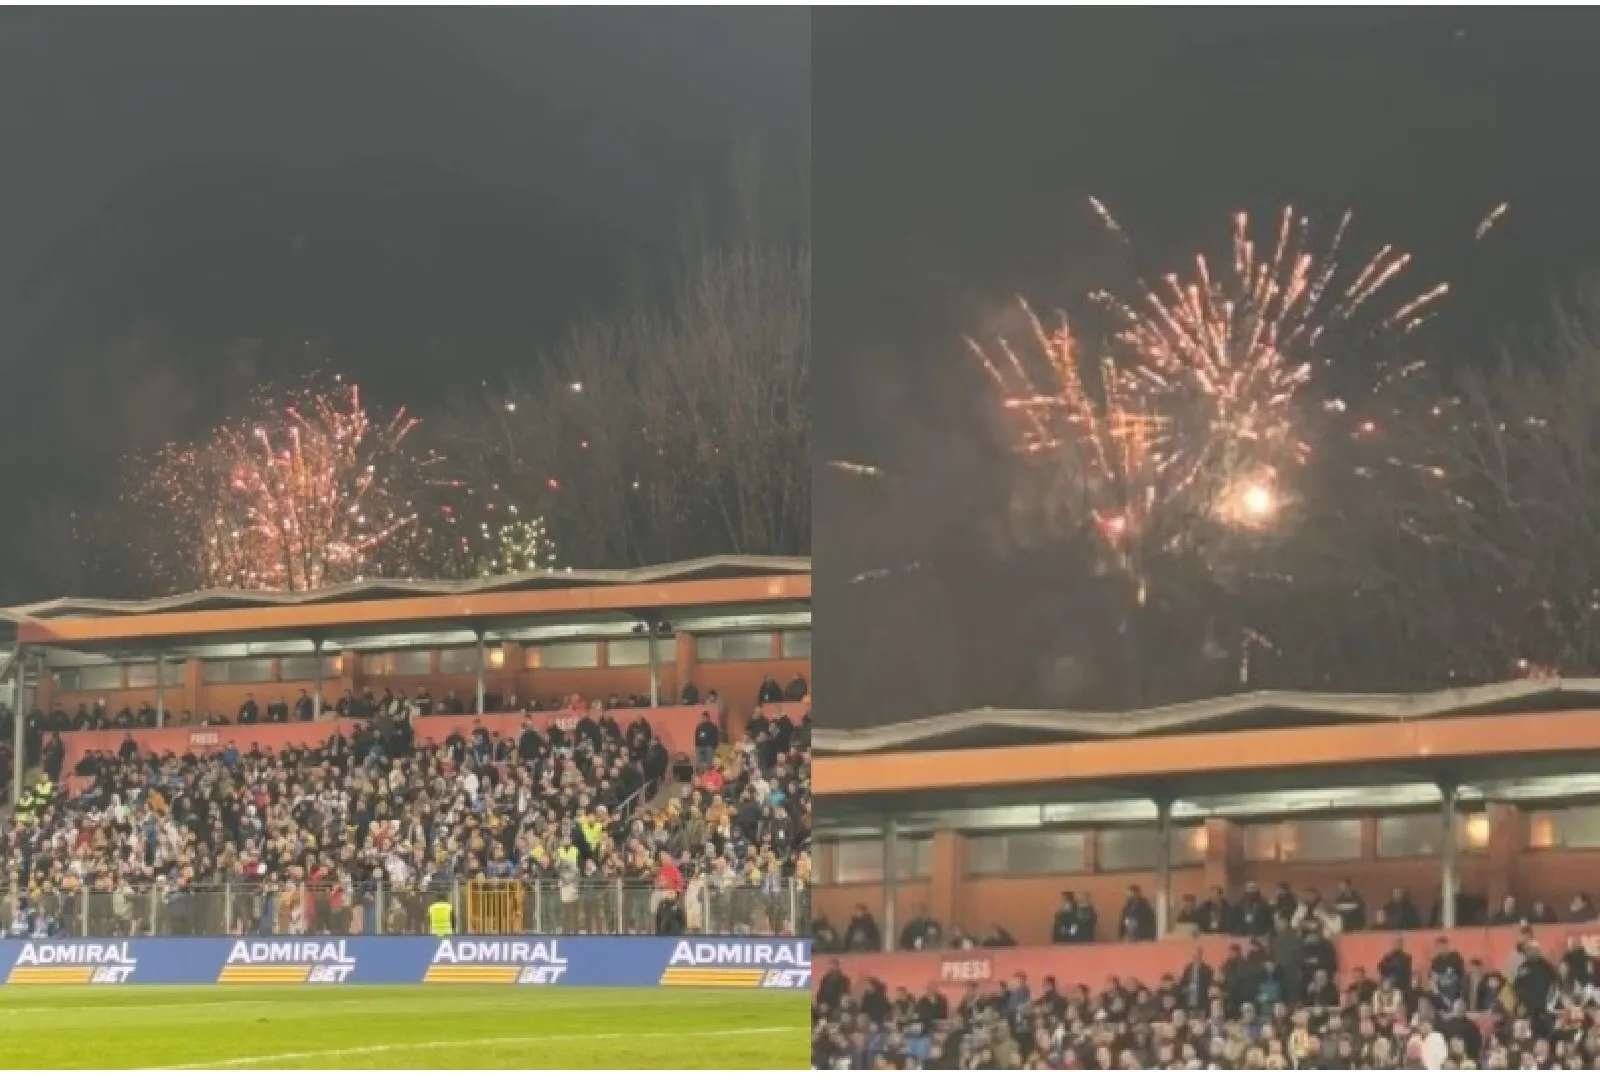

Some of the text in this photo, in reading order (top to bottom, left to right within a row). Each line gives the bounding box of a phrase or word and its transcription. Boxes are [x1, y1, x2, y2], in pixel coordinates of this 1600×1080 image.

[16, 941, 137, 965] ADMIRAL
[227, 940, 356, 963] ADMIRAL
[432, 939, 568, 963] ADMIRAL
[669, 940, 811, 967] ADMIRAL
[942, 961, 991, 980] PRESS
